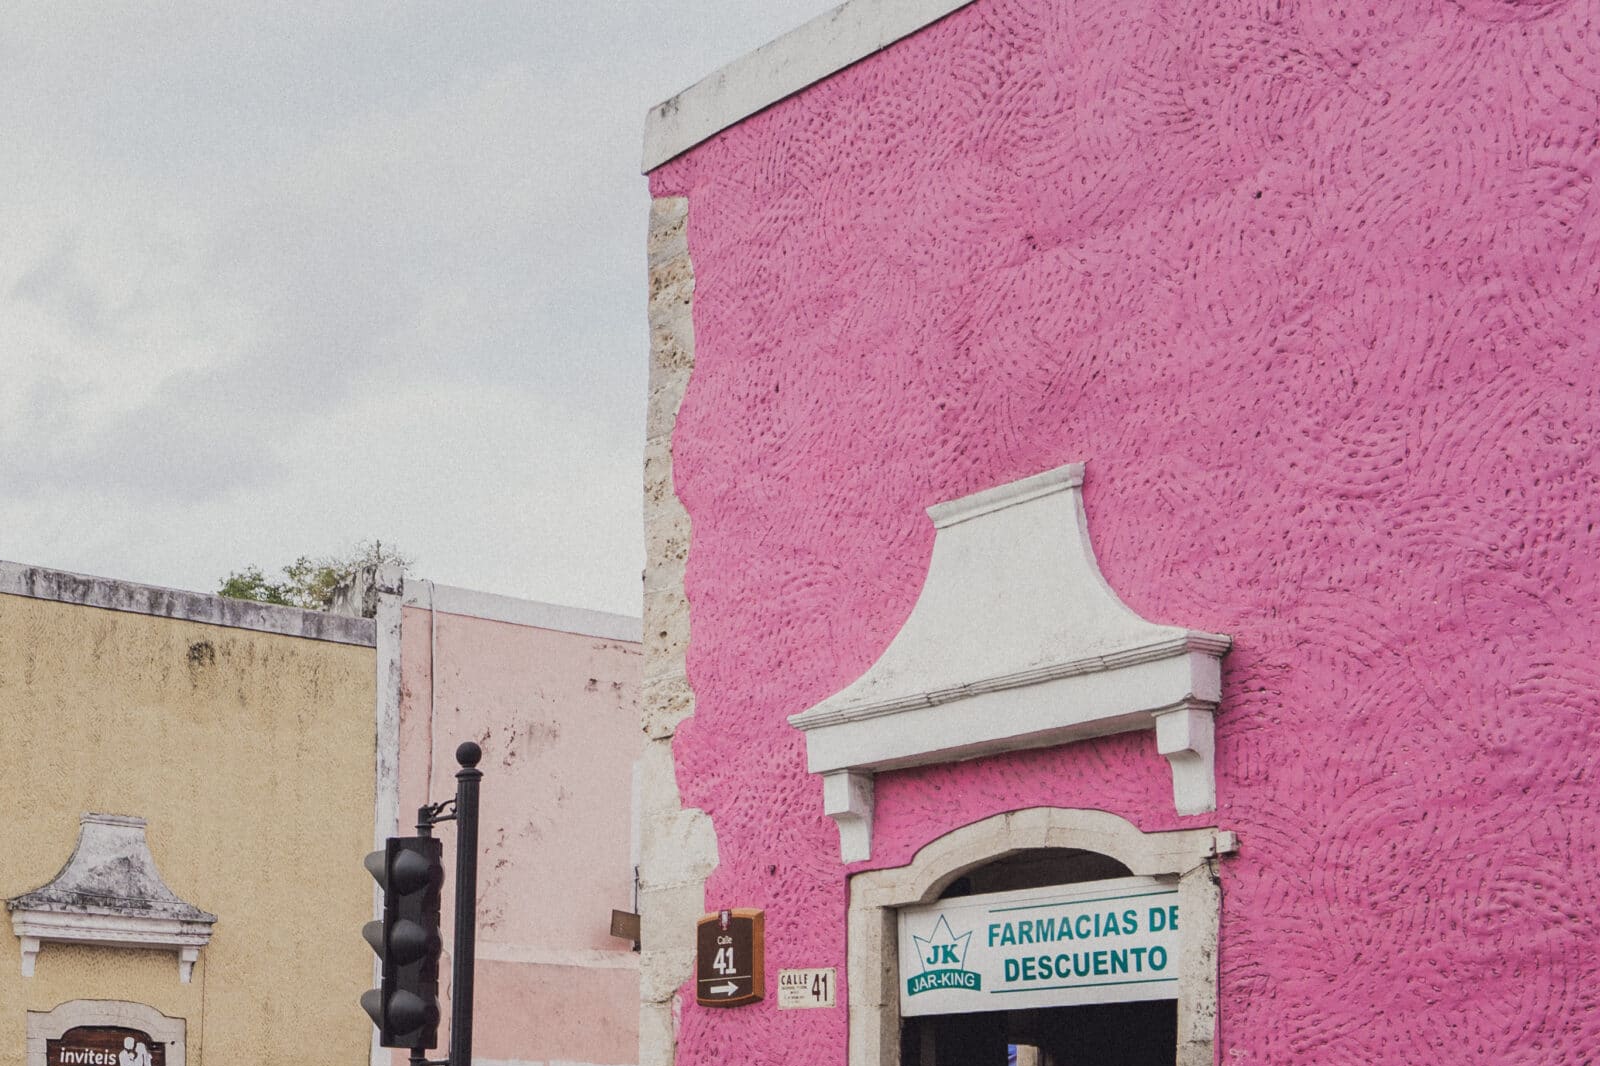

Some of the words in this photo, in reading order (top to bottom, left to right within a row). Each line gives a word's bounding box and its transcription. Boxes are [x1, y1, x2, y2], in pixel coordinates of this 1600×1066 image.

[988, 909, 1138, 947] FARMACIAS
[712, 947, 737, 975] 41
[926, 944, 960, 965] JK
[1005, 946, 1167, 982] DESCUENTO
[812, 973, 827, 1001] 41
[913, 972, 975, 993] JAR-KING
[60, 1047, 117, 1066] inviteis
